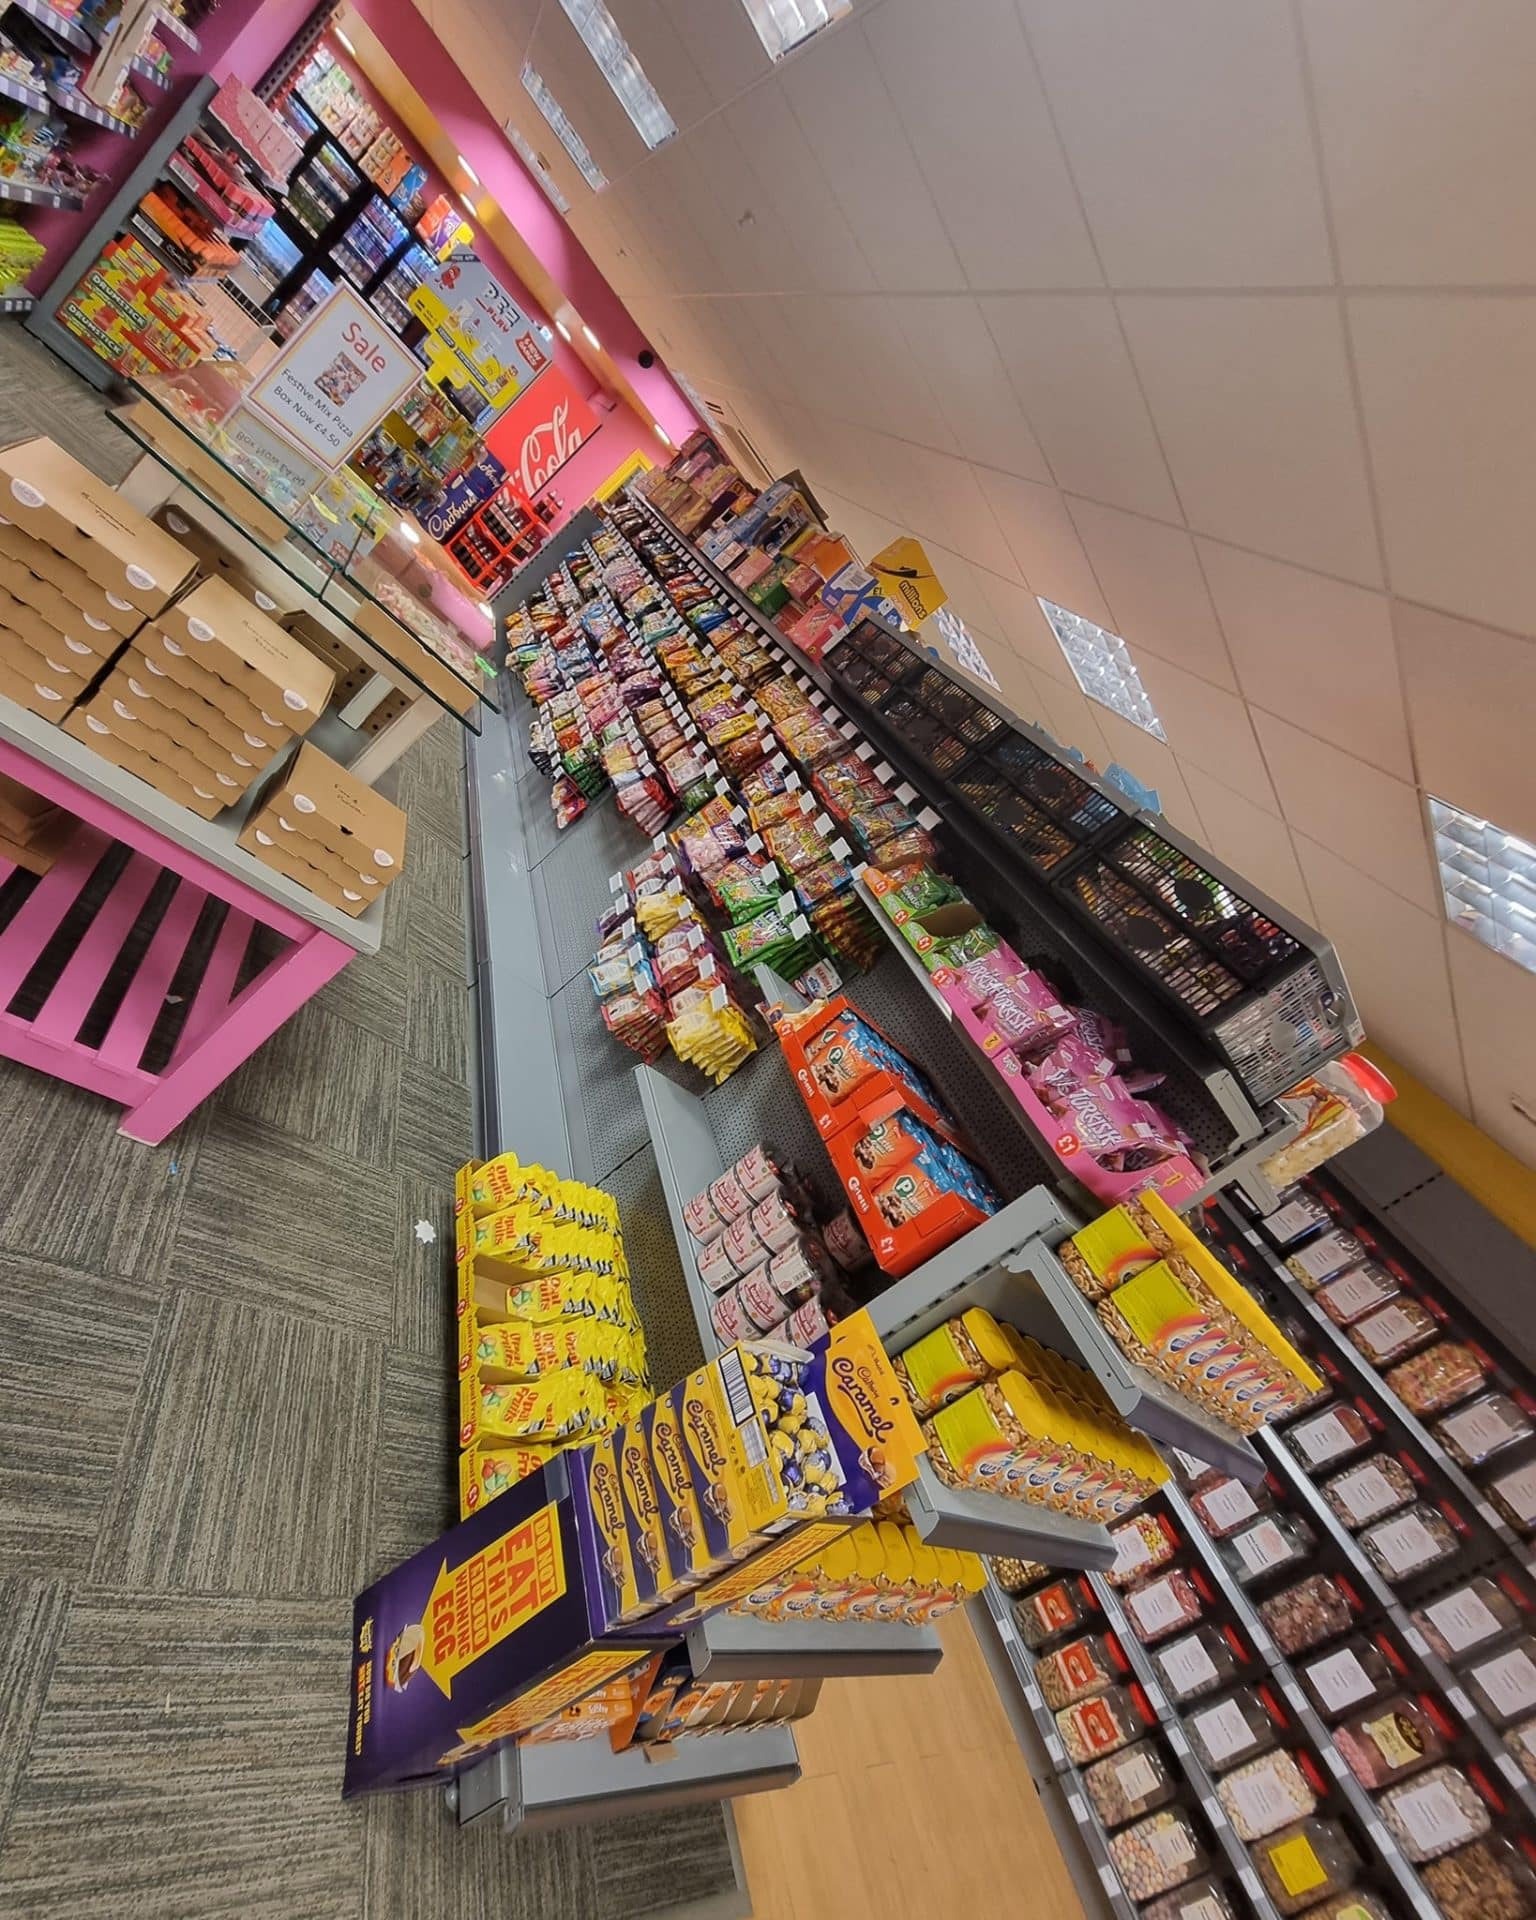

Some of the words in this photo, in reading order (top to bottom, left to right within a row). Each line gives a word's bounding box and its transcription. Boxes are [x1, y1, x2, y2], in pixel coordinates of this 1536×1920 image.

[92, 274, 147, 326] DRUMSTICK
[68, 304, 122, 355] DRUMSTICK
[342, 322, 386, 373] Sale
[274, 385, 293, 405] Box
[293, 402, 315, 425] Now
[314, 421, 341, 447] £4.50
[281, 368, 314, 401] Festive
[315, 399, 332, 417] Mix
[333, 416, 354, 438] Pizza
[899, 580, 928, 620] millions
[933, 971, 946, 984] £1
[819, 1115, 831, 1129] £1
[1070, 1088, 1122, 1147] TURKISH
[1056, 1136, 1075, 1154] £1
[497, 1165, 514, 1196] Opal
[881, 1237, 895, 1254] £1
[510, 1333, 525, 1366] Opal
[517, 1391, 540, 1422] Opal
[832, 1357, 894, 1444] Caramel
[656, 1422, 692, 1500] Caramel
[686, 1400, 727, 1477] Caramel
[593, 1463, 626, 1540] Caramel
[625, 1447, 659, 1525] Caramel
[535, 1519, 550, 1545] DO
[487, 1547, 509, 1632] THIS
[505, 1524, 540, 1617] EAT
[537, 1548, 556, 1594] NOT
[432, 1589, 457, 1667] EGG
[455, 1569, 472, 1660] WINNING
[469, 1557, 490, 1652] £10,000
[354, 1713, 362, 1755] YOURS?
